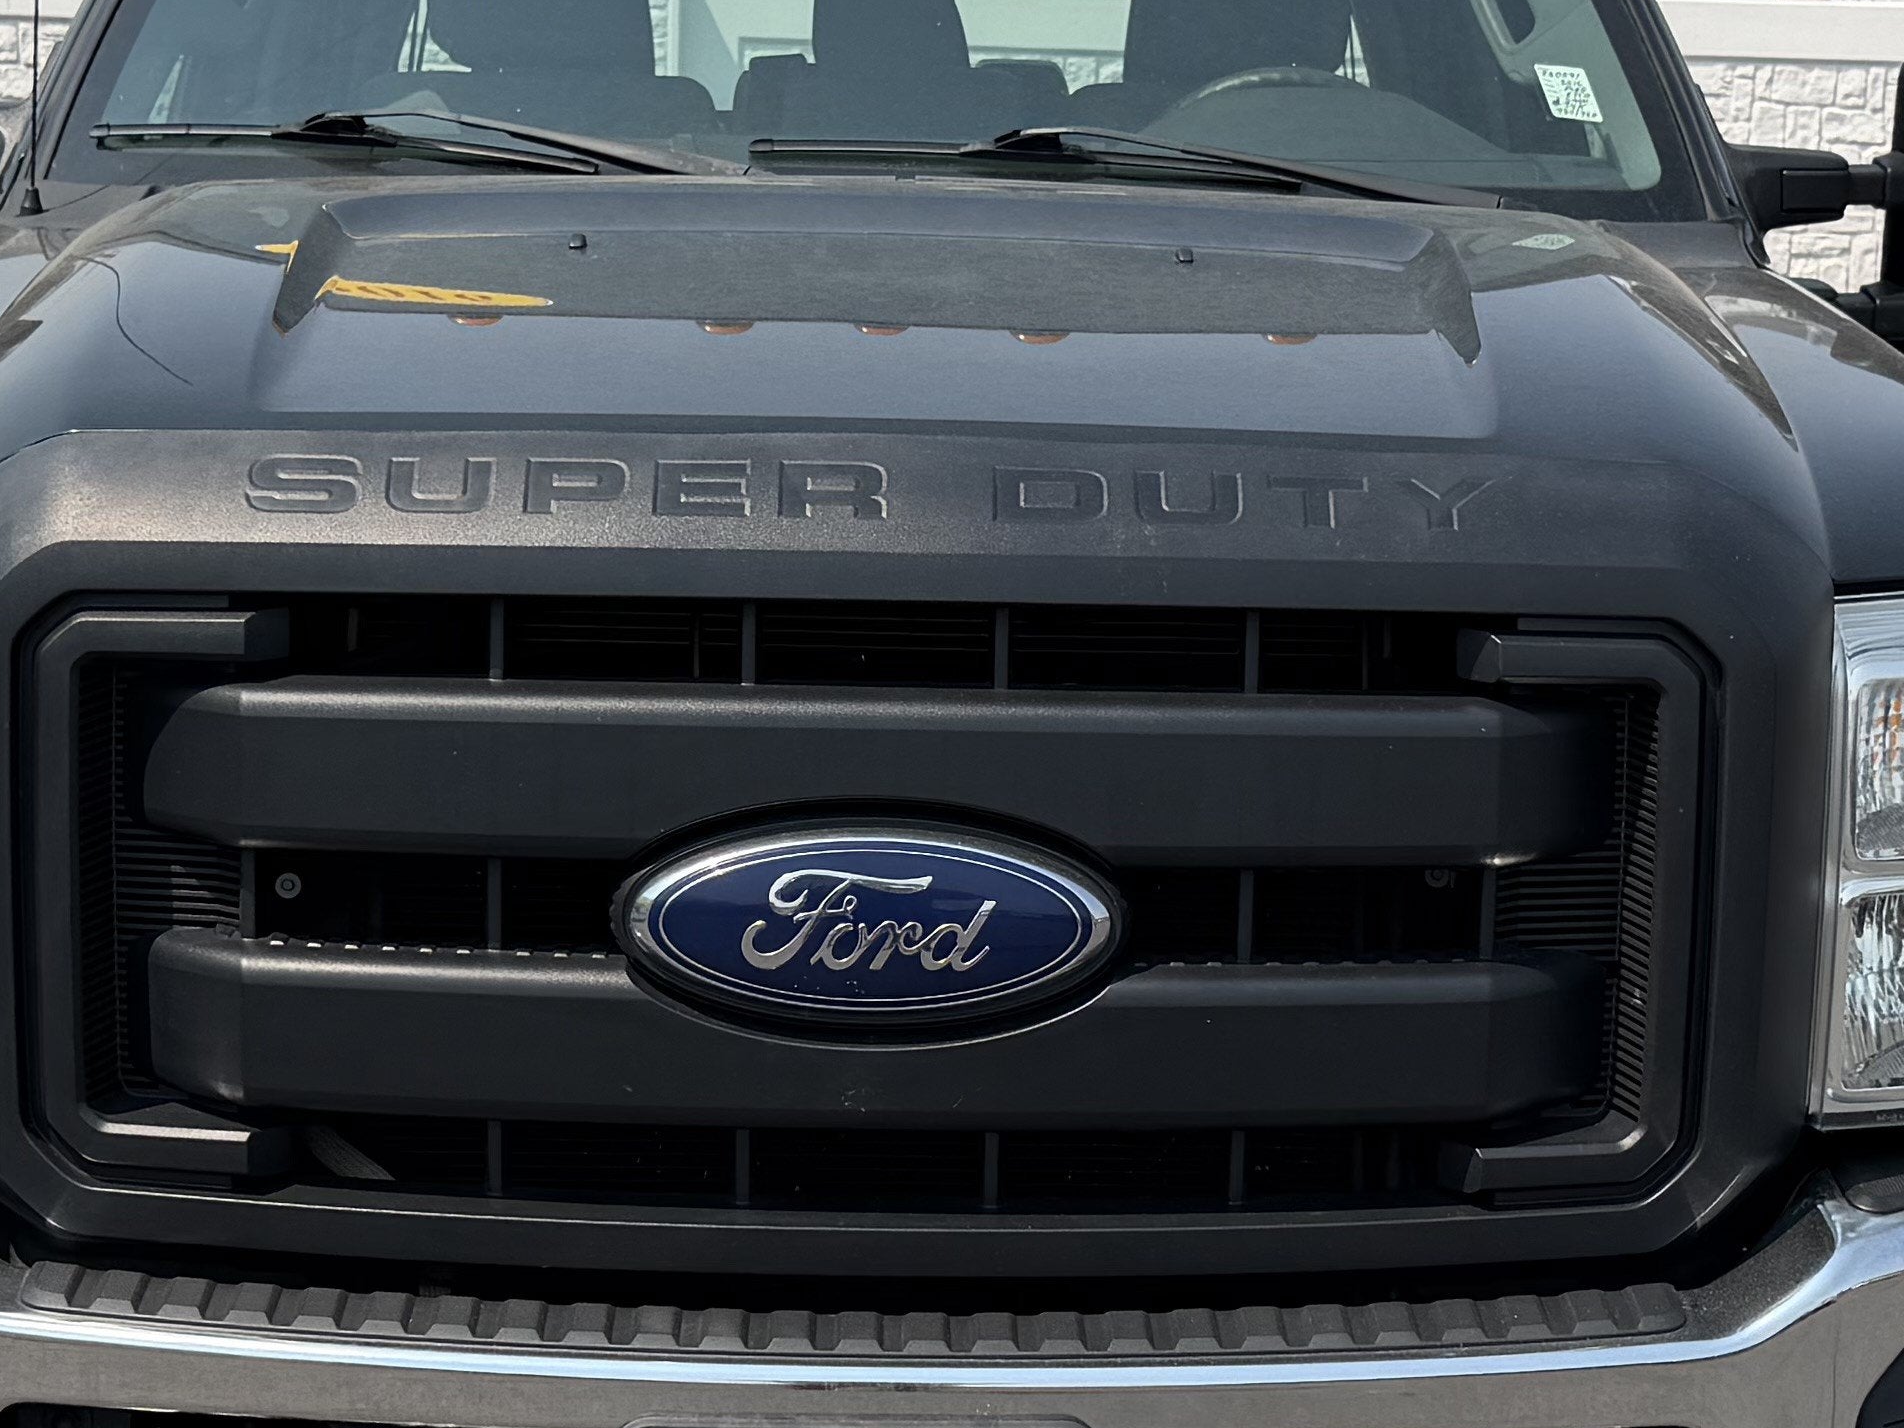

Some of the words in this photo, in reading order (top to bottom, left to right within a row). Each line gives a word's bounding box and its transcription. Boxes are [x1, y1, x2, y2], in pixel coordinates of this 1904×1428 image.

[245, 453, 889, 519] SUPER
[992, 465, 1511, 531] DUTY
[741, 868, 997, 973] Ford
